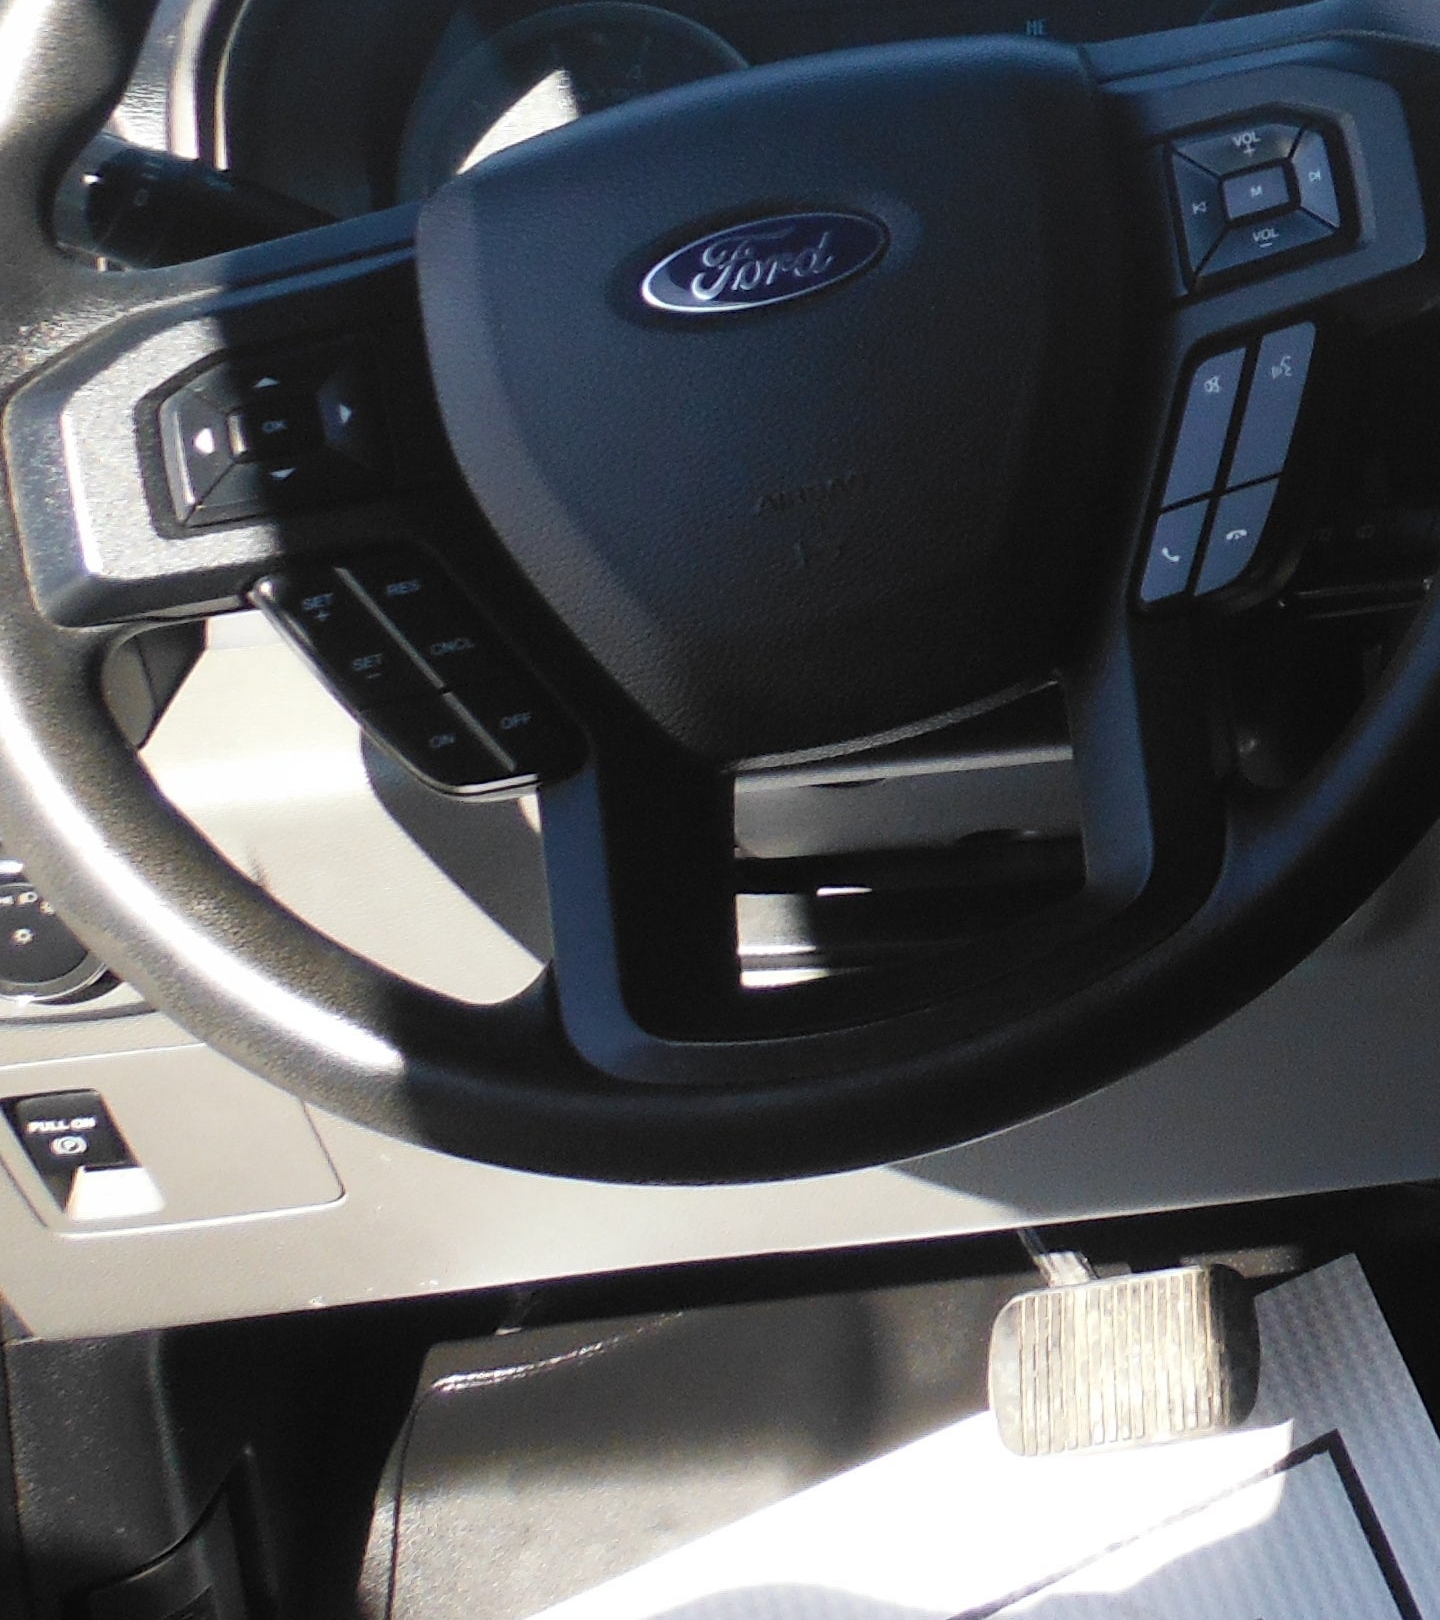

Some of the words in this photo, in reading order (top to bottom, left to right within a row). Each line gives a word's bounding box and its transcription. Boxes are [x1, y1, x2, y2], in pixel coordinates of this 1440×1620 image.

[1231, 129, 1262, 147] VOL
[1249, 184, 1263, 199] M
[1251, 227, 1281, 243] VOL
[690, 226, 835, 301] Ford
[262, 419, 289, 435] OK
[301, 592, 335, 612] SET
[429, 636, 476, 657] CNCL
[351, 652, 384, 672] SET
[499, 711, 533, 731] OFF
[428, 733, 458, 750] ON
[26, 1119, 70, 1134] PULL
